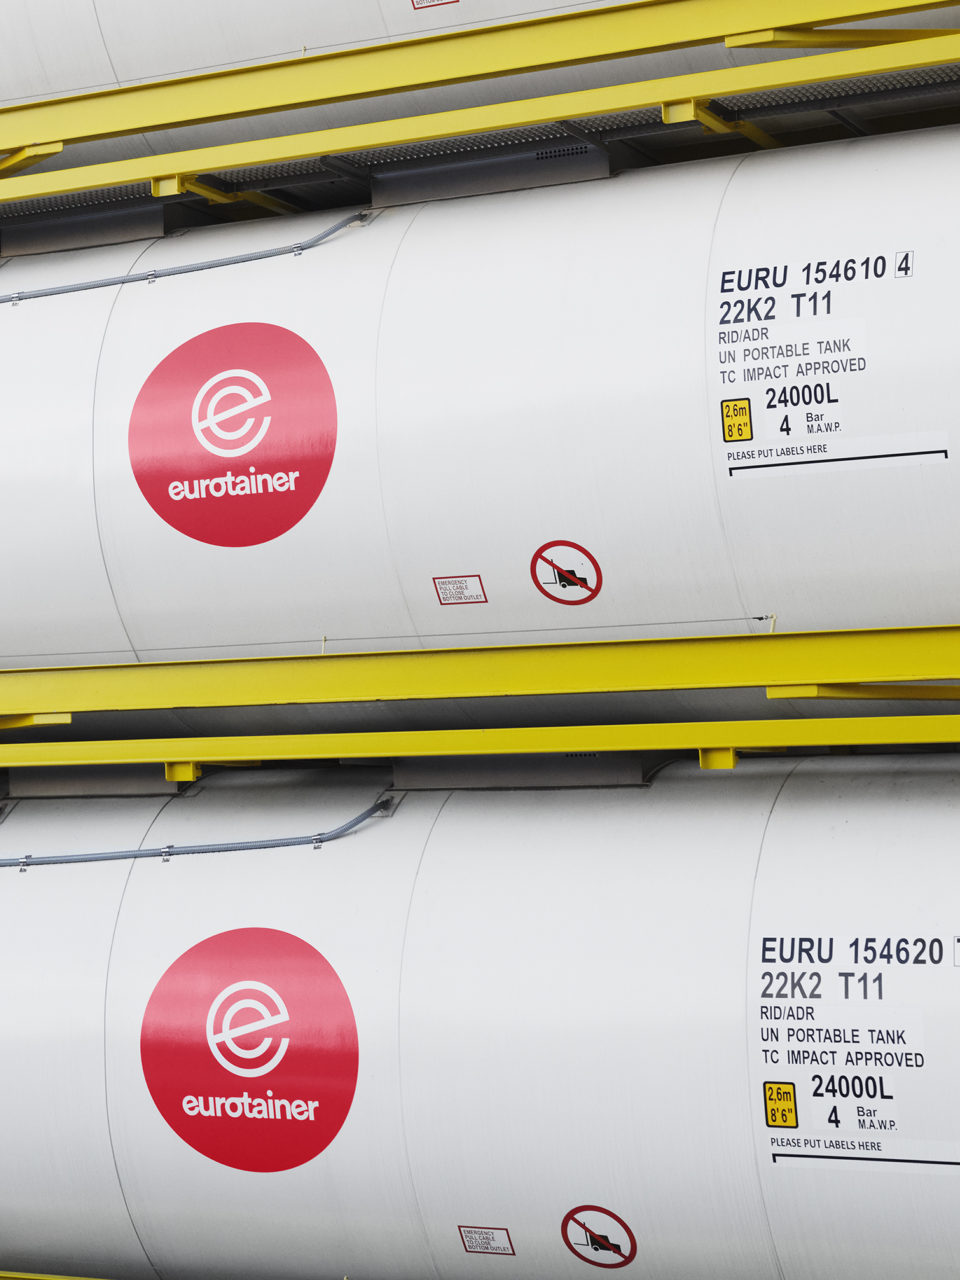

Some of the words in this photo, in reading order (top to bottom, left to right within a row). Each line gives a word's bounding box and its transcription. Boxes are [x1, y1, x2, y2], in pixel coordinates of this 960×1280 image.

[720, 265, 788, 293] EURU
[802, 256, 886, 285] 154610
[898, 253, 910, 276] 4
[719, 296, 776, 325] 22K2
[791, 291, 831, 317] T11
[719, 328, 769, 344] RID/ADR
[719, 350, 735, 364] UN
[743, 343, 810, 362] PORTABLE
[817, 339, 851, 354] TANK
[720, 371, 736, 384] TC
[743, 365, 789, 382] IMPACT
[796, 358, 866, 377] APPROVED
[766, 383, 838, 409] 24000L
[780, 415, 791, 436] 4
[806, 413, 824, 423] Bar
[807, 422, 841, 434] M.A.W.P.
[727, 451, 755, 461] PLEASE
[758, 449, 773, 458] PUT
[776, 446, 804, 456] LABELS
[806, 444, 827, 454] HERE
[168, 466, 299, 500] eurotainer
[762, 938, 834, 963] EURU
[849, 938, 943, 964] 154620
[761, 972, 822, 998] 22K2
[839, 972, 882, 999] T11
[760, 1006, 814, 1020] RID/ADR
[761, 1028, 779, 1042] UN
[787, 1029, 860, 1043] PORTABLE
[868, 1030, 906, 1045] TANK
[762, 1050, 779, 1063] TC
[787, 1050, 837, 1065] IMPACT
[845, 1052, 924, 1067] APPROVED
[812, 1075, 893, 1099] 24000L
[182, 1090, 319, 1120] eurotainer
[857, 1107, 877, 1117] Bar
[828, 1106, 840, 1128] 4
[858, 1119, 898, 1131] M.A.W.P.
[771, 1138, 801, 1148] PLEASE
[804, 1139, 821, 1149] PUT
[824, 1140, 856, 1150] LABELS
[858, 1141, 882, 1151] HERE
